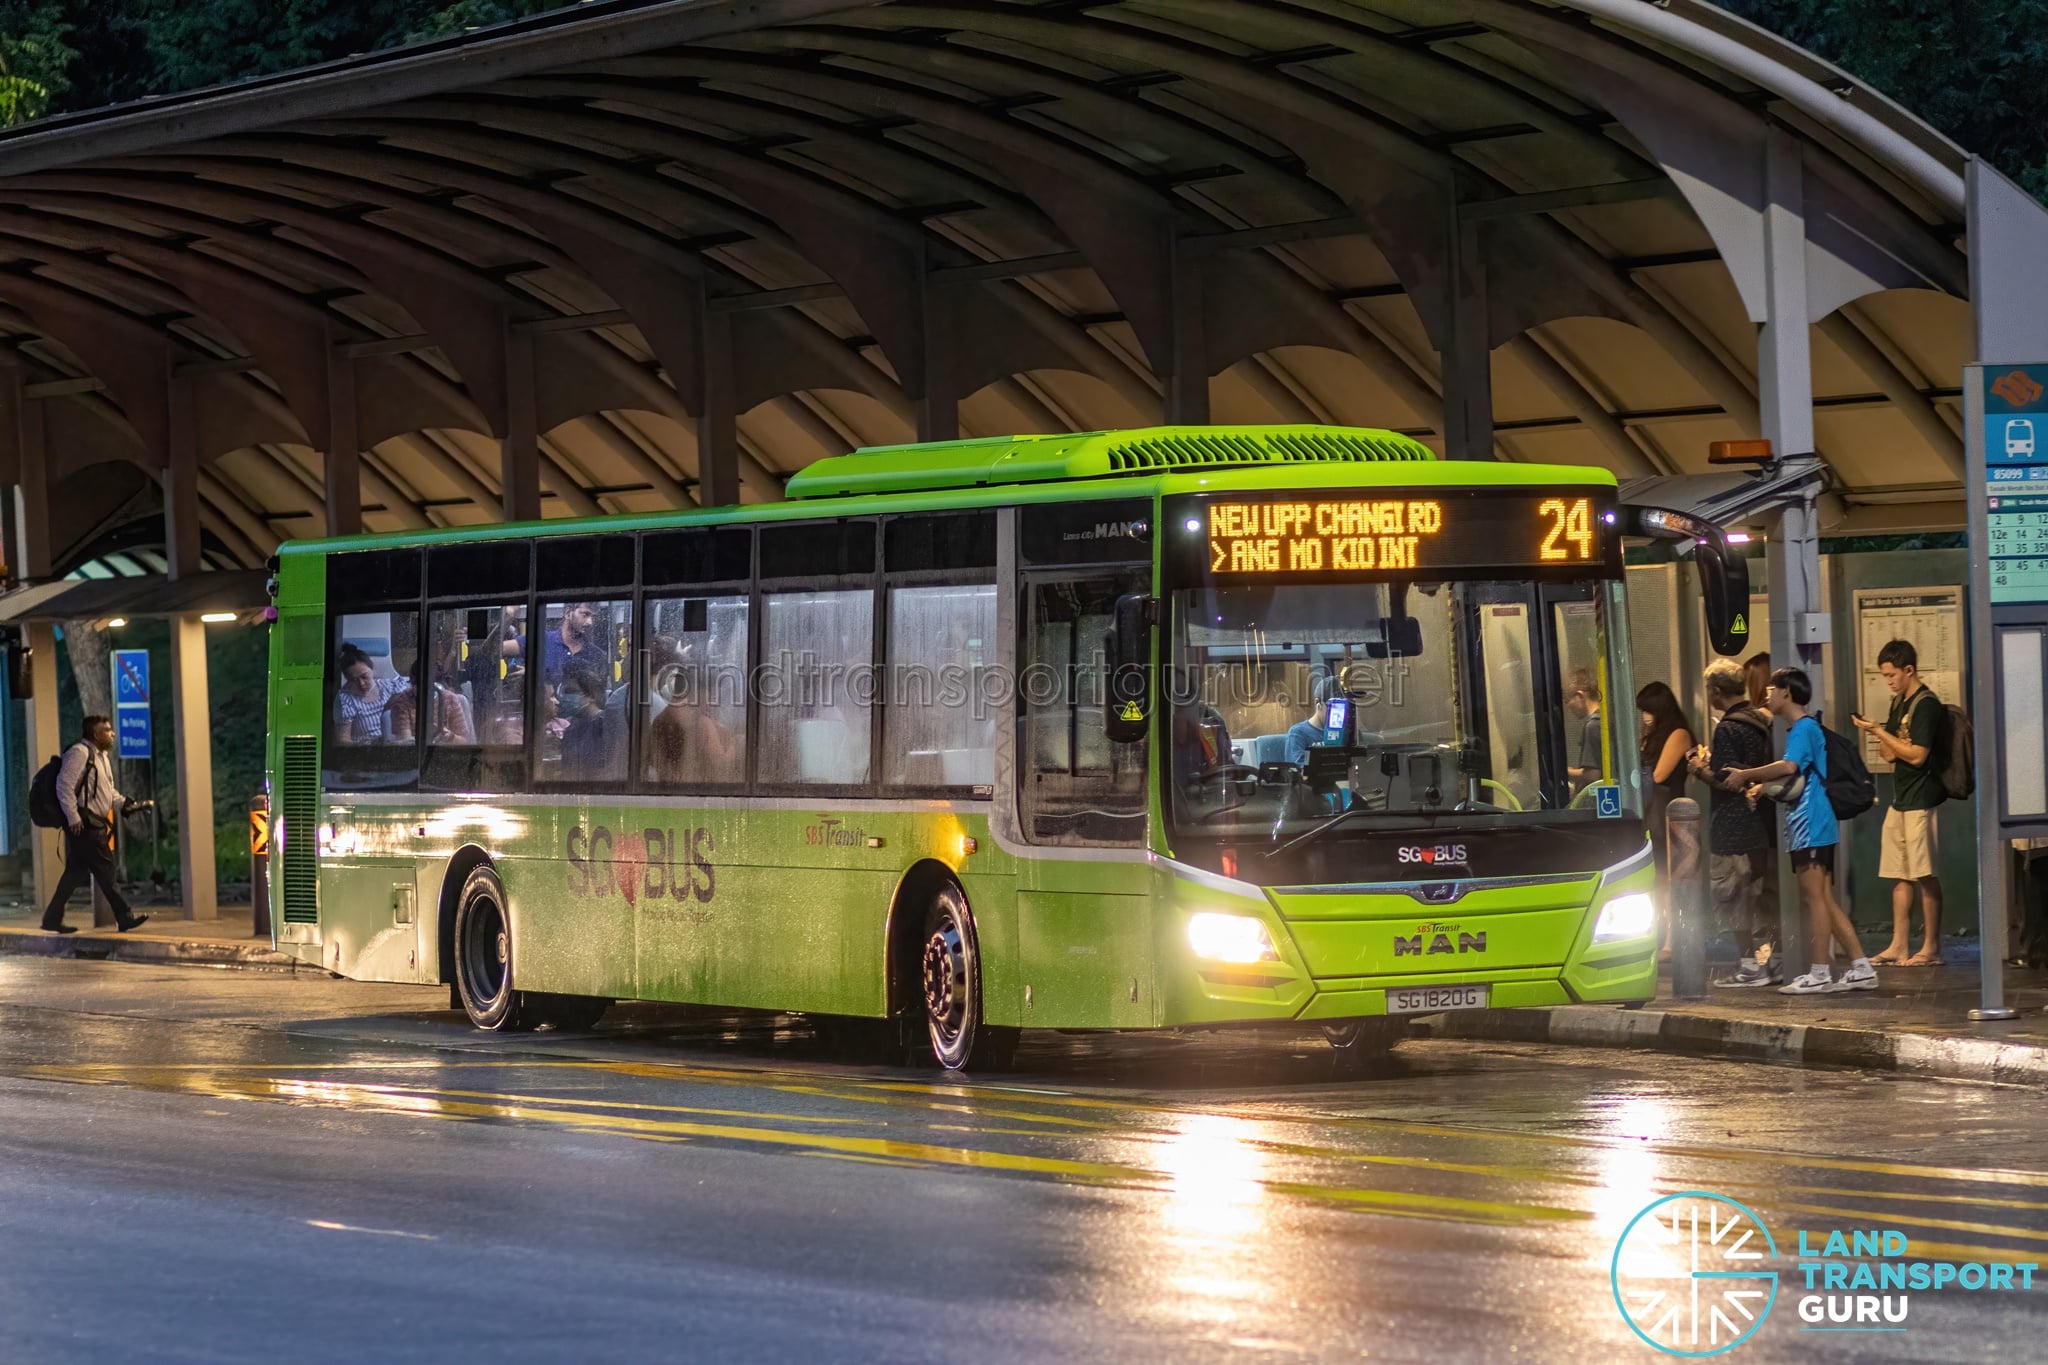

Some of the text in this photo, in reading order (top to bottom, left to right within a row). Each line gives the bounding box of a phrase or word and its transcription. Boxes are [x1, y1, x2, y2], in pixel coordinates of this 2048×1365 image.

[1210, 502, 1441, 537] NEW UPP CHANGI RD
[1539, 499, 1592, 559] 24
[1995, 515, 2002, 525] 2
[2018, 514, 2025, 524] 9
[1095, 521, 1132, 539] MAN
[1991, 529, 2008, 540] 12e
[2015, 529, 2027, 539] 14
[1231, 536, 1419, 571] ANG MO KIO INT
[1994, 543, 2006, 555] 31
[2015, 543, 2028, 554] 35
[1995, 560, 2007, 571] 38
[2016, 560, 2029, 571] 45
[1994, 575, 2008, 586] 48
[805, 819, 867, 849] SBS Transit
[1398, 844, 1467, 863] SG BUS
[644, 827, 715, 903] BUS
[1416, 921, 1462, 934] SBS Transit
[1394, 931, 1487, 957] MAN
[1398, 988, 1477, 1009] SG1820G
